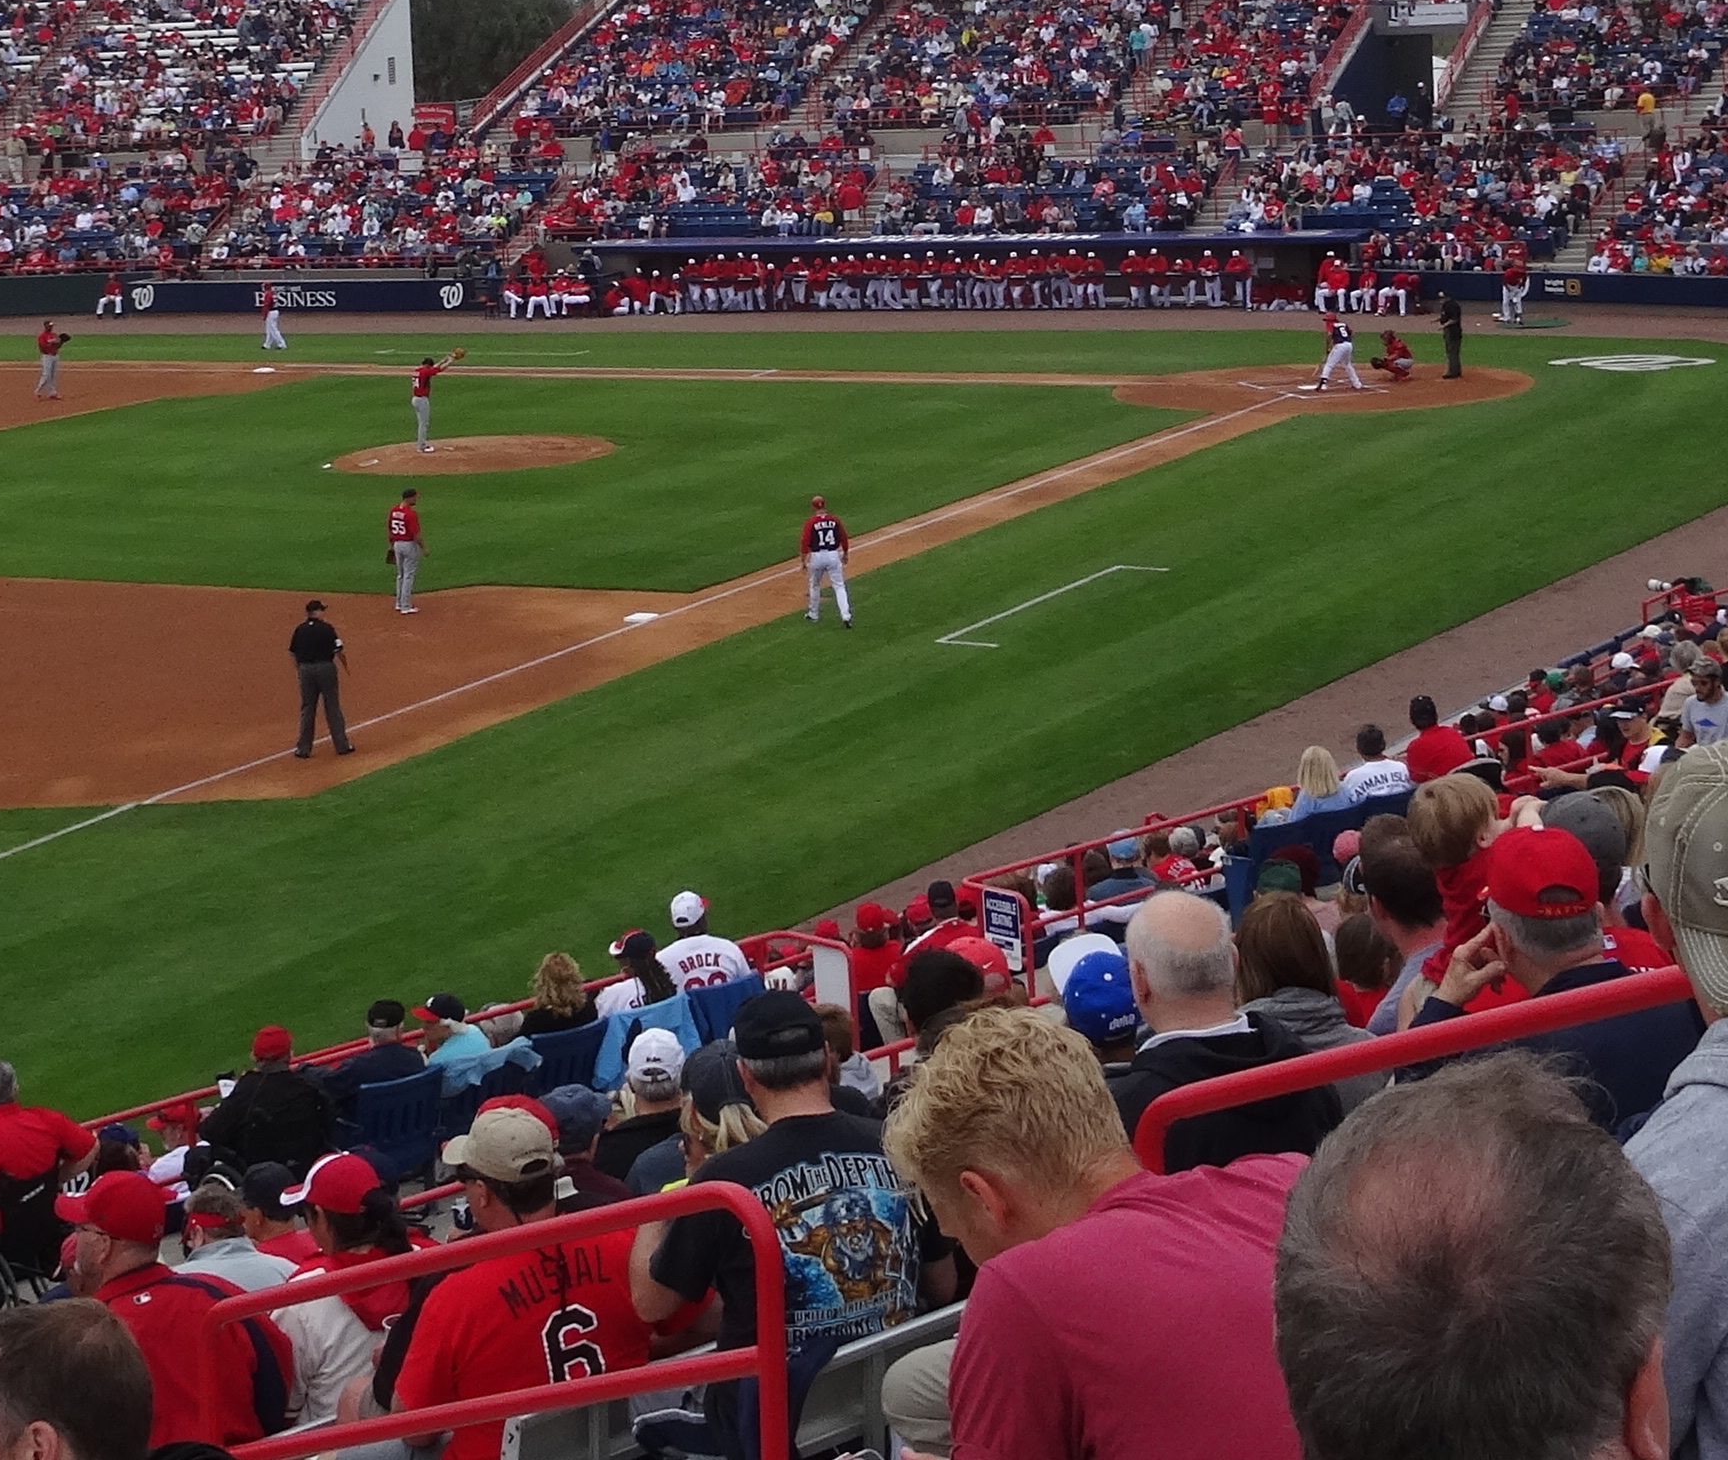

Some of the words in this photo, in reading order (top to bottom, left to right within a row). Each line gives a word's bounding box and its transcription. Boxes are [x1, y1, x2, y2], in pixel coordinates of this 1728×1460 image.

[255, 291, 336, 307] BSINESS
[391, 519, 407, 535] 55
[818, 529, 835, 546] 14
[678, 953, 722, 973] BROCK
[753, 1164, 811, 1210] ROM
[541, 1303, 606, 1385] 6
